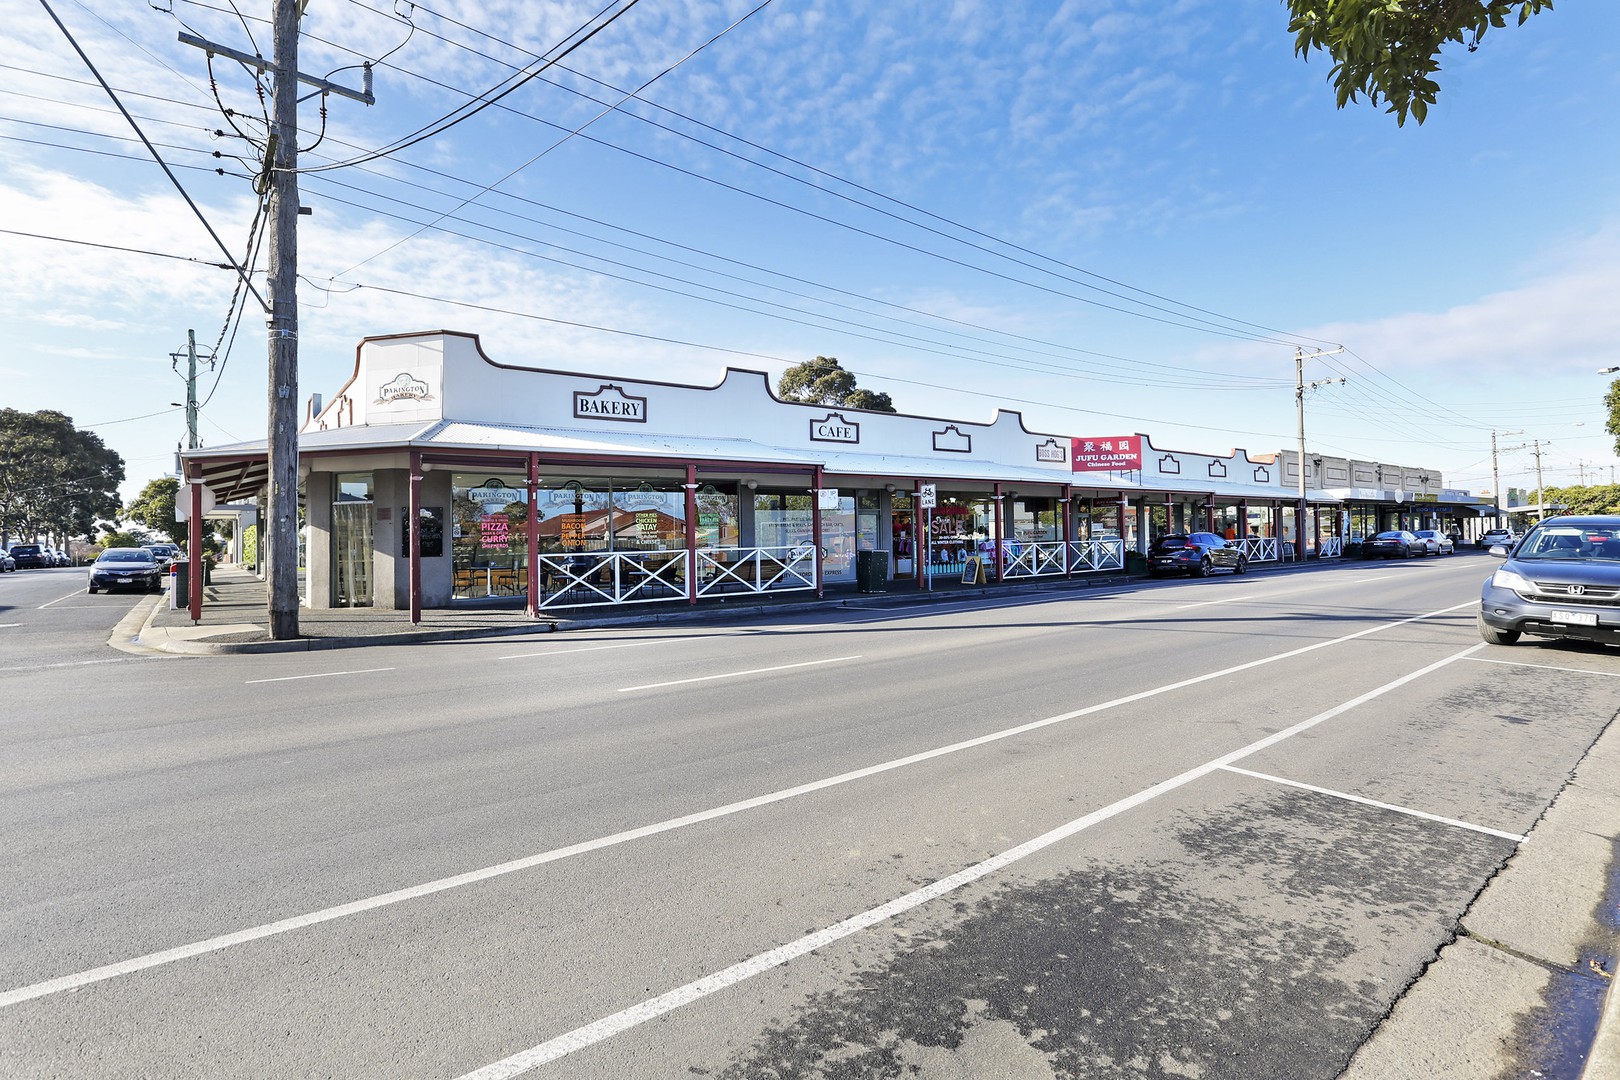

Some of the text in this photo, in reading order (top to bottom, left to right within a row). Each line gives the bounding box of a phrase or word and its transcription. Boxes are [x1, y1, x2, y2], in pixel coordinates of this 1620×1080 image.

[383, 386, 425, 396] PAKINGTON
[580, 398, 640, 416] BAKERY
[818, 425, 852, 439] CAFE
[1075, 453, 1137, 462] JUFU GARDEN
[472, 492, 517, 501] PAKINGTON
[627, 494, 665, 502] PAKINGTON
[481, 523, 509, 531] PIZZA
[931, 519, 965, 535] SALE
[481, 535, 509, 543] CURRY
[1577, 614, 1595, 623] 370
